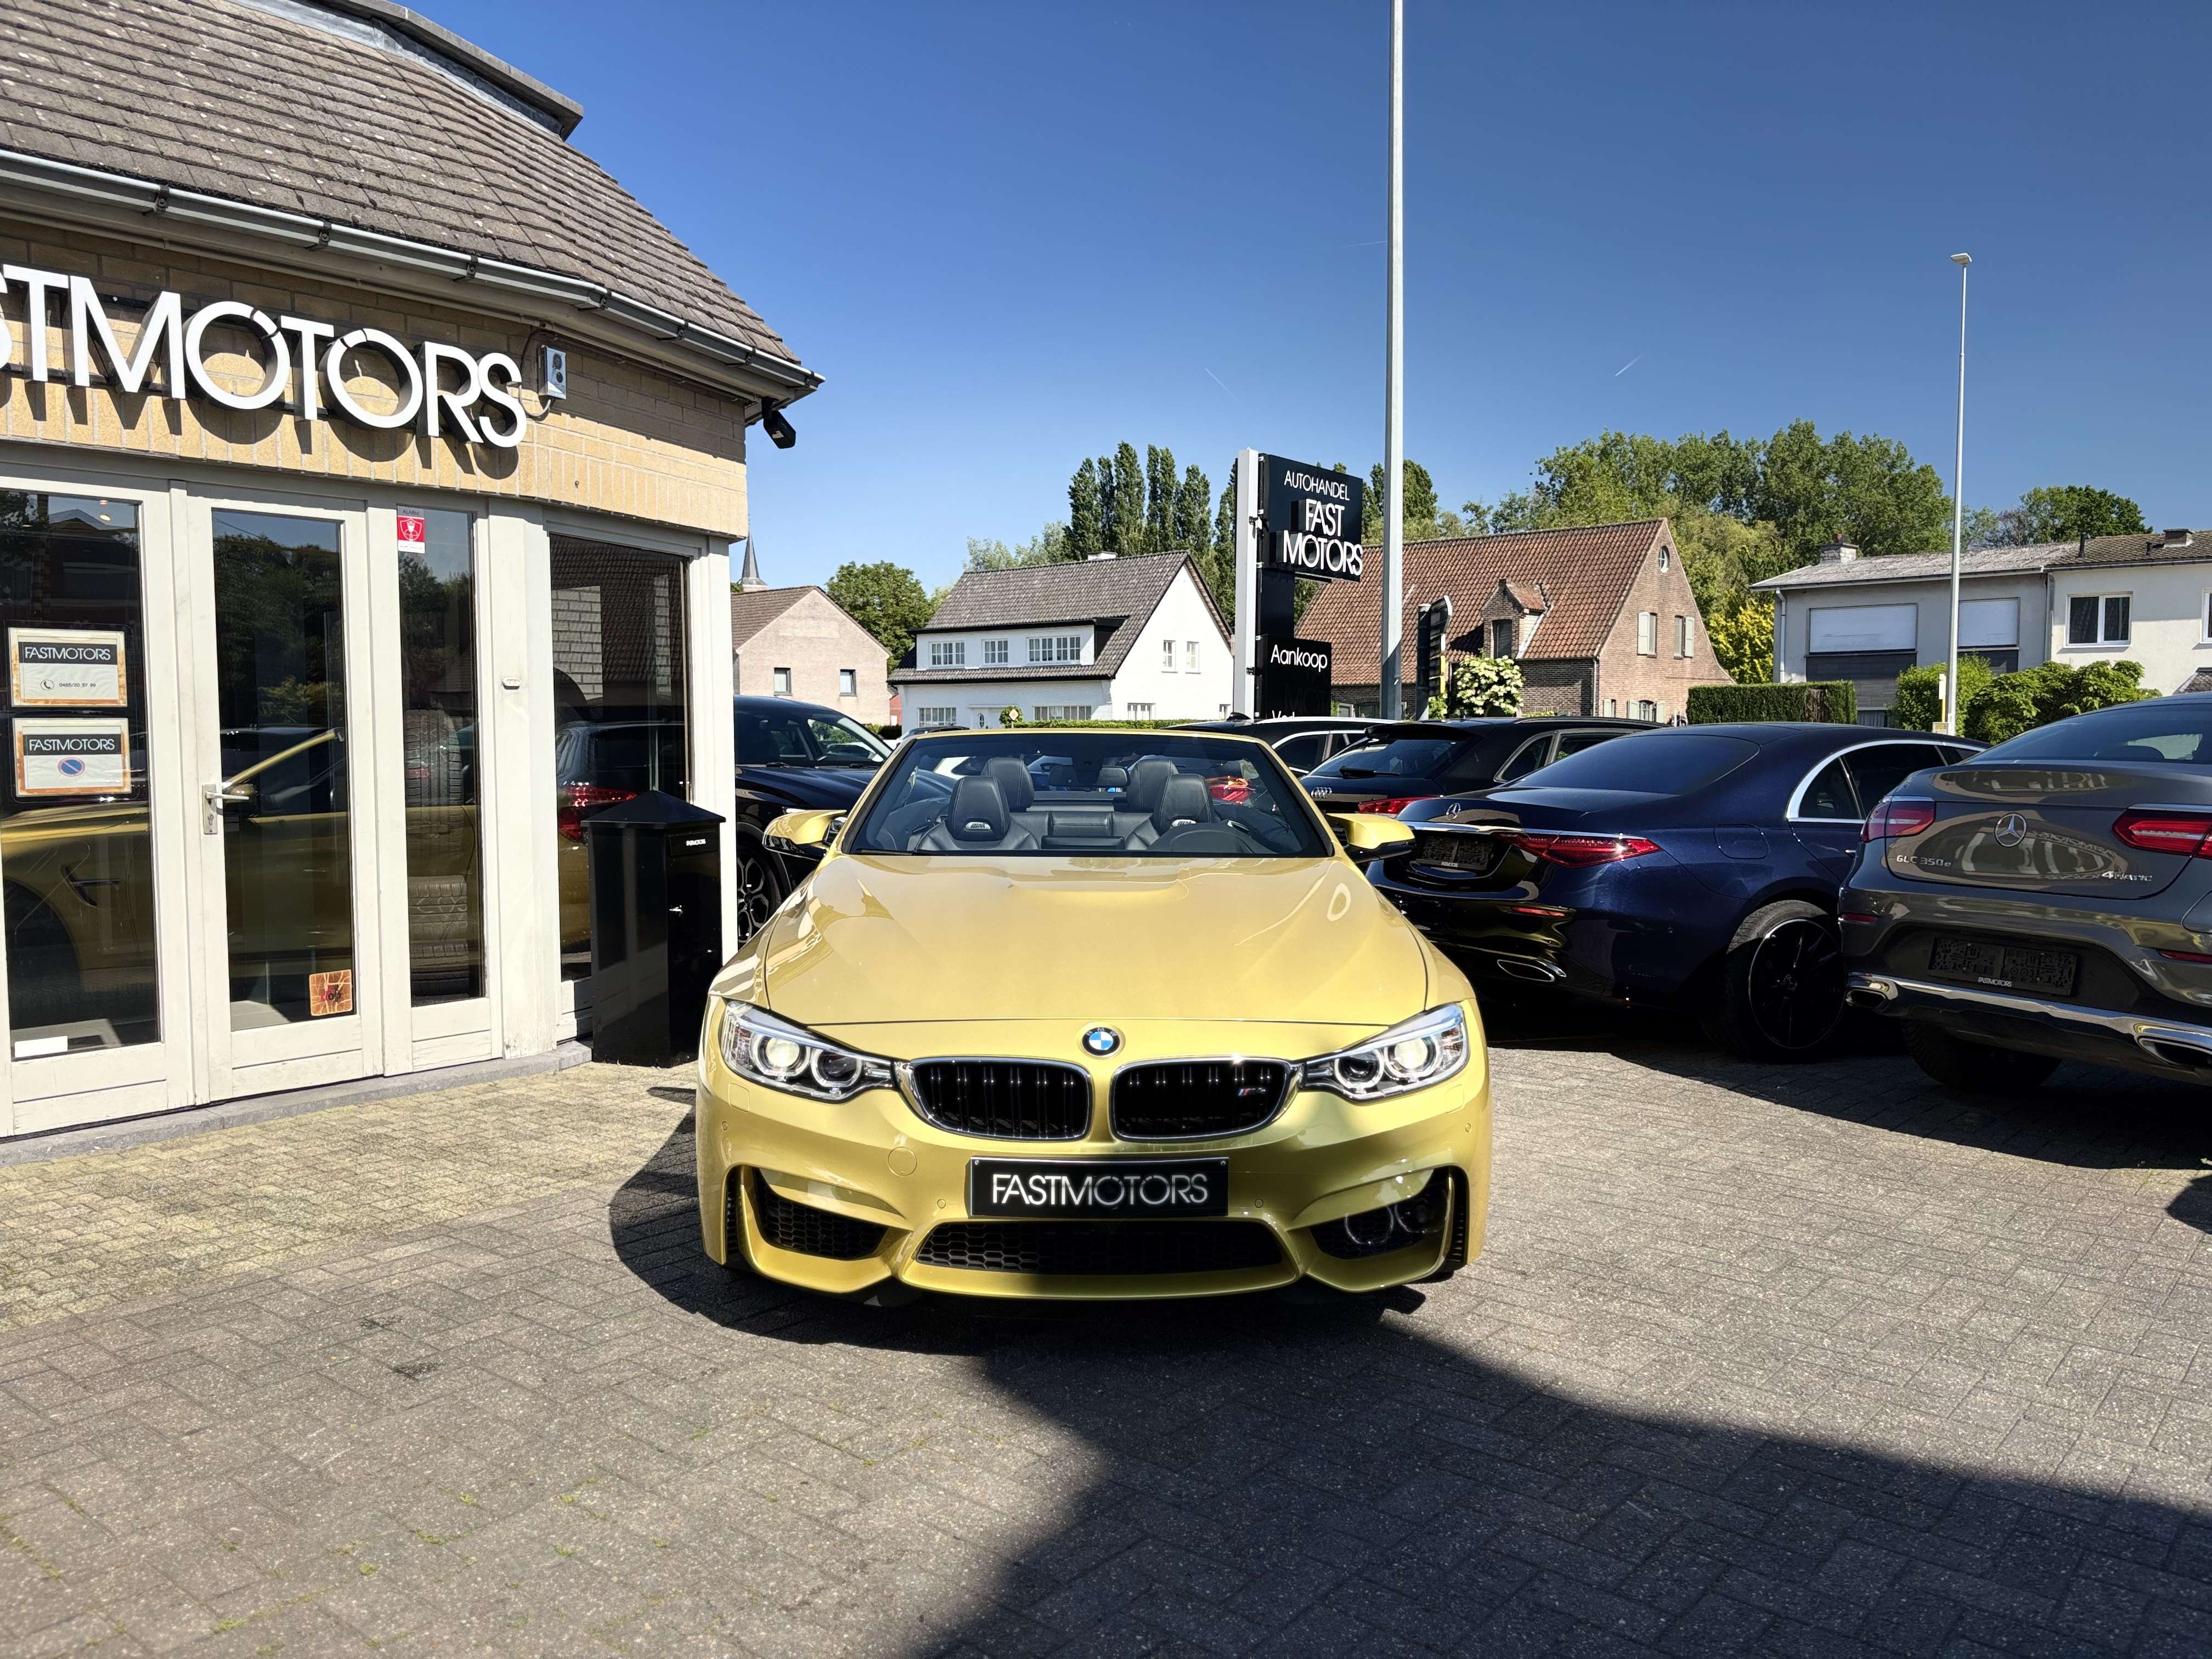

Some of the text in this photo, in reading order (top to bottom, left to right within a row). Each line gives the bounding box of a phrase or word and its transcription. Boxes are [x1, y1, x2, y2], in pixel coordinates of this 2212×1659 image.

[0, 264, 528, 448] TMOTORS
[1284, 470, 1350, 501] AUTOHANDEL
[1306, 498, 1345, 537] FAST
[1283, 529, 1363, 576] MOTORS
[25, 647, 111, 661] FASTMOTORS
[1271, 644, 1328, 673] Aankoop
[29, 738, 115, 751] FASTMOTORS
[1896, 855, 1918, 864] GLC
[1086, 1028, 1118, 1036] BMW
[992, 1172, 1208, 1206] FASTMOTORS
